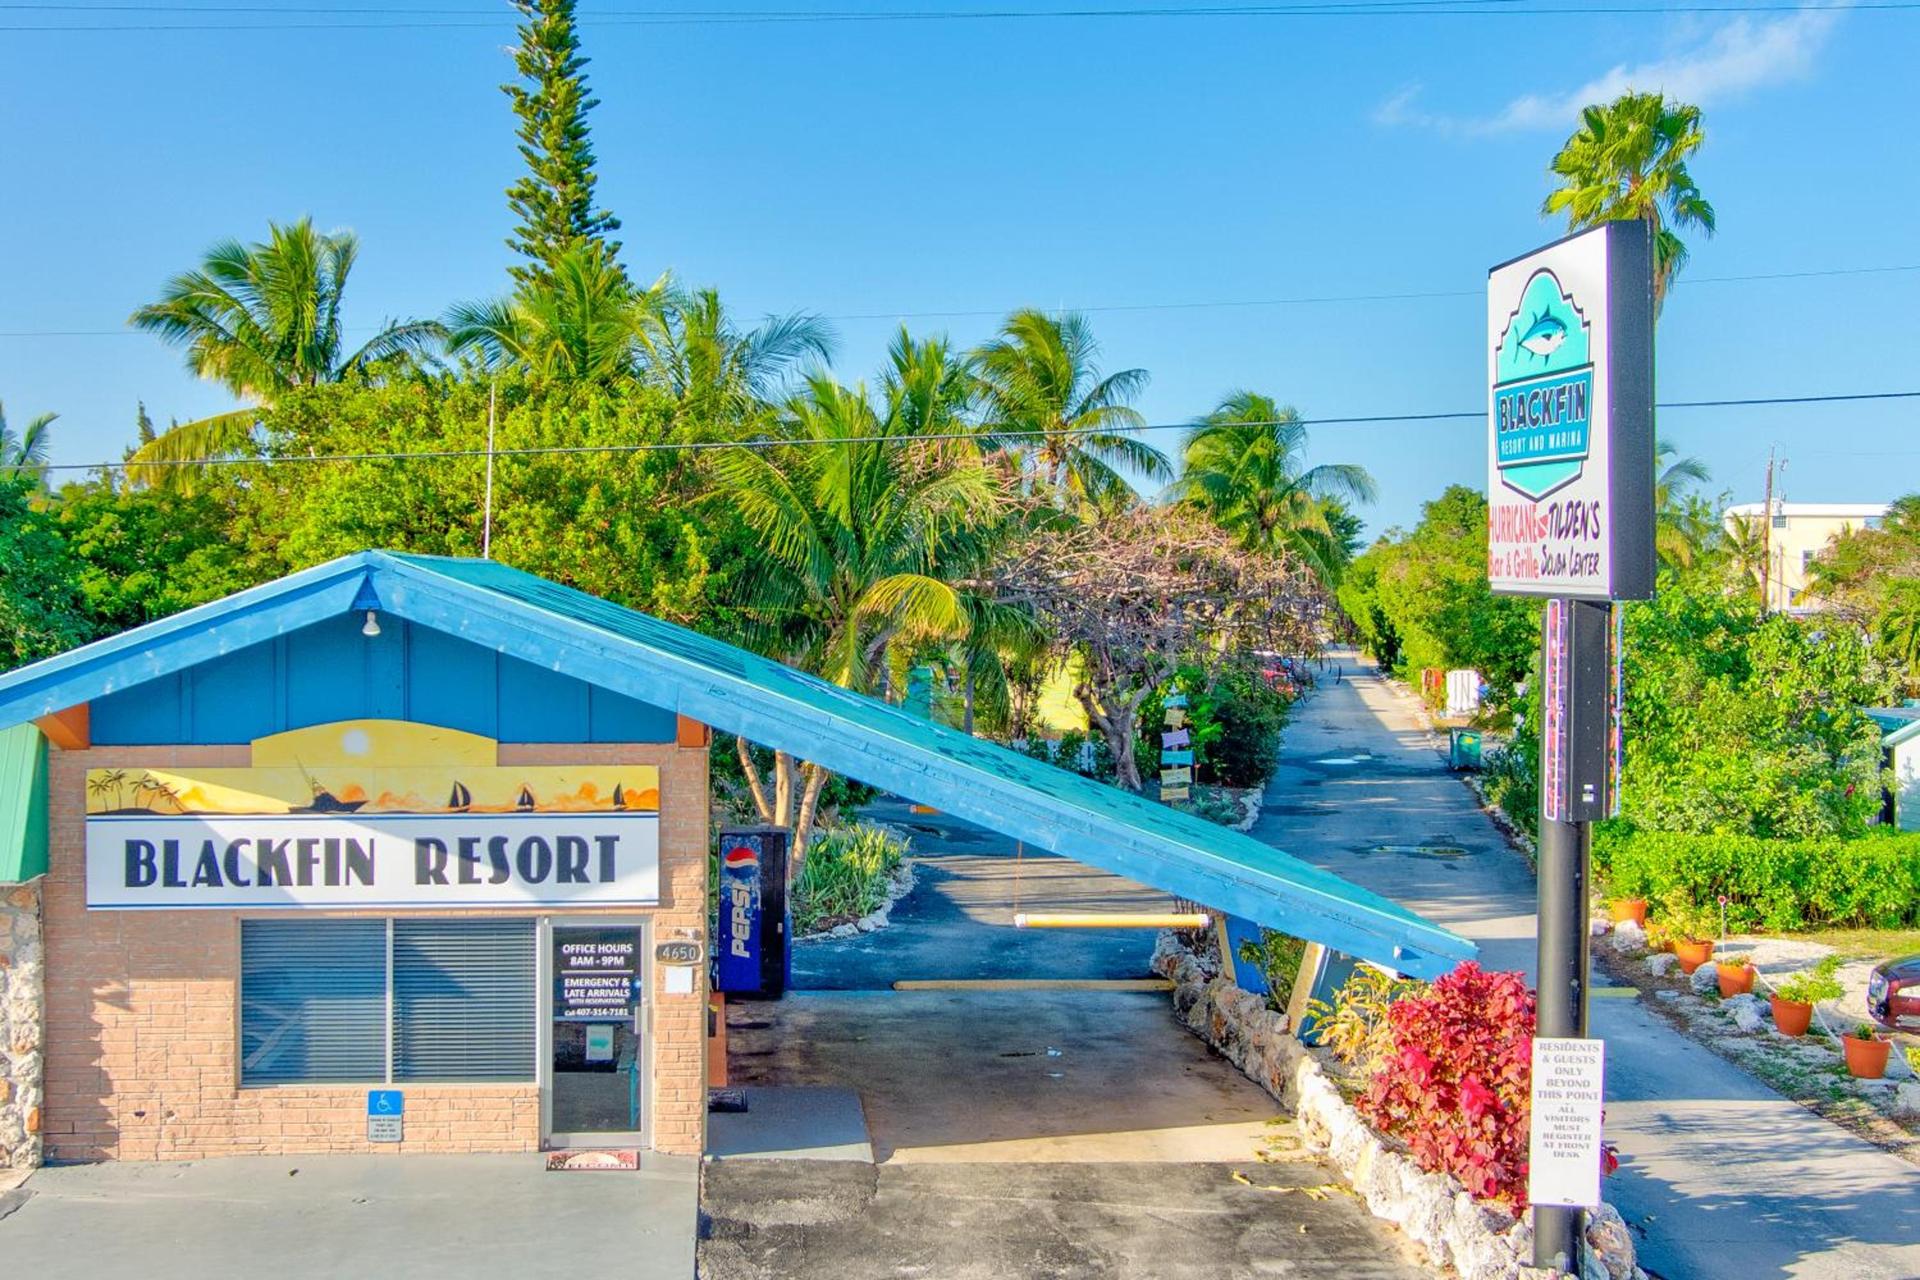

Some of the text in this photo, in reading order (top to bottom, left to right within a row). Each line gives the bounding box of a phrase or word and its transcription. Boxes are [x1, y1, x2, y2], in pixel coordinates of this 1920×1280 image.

[1500, 381, 1586, 434] BLACKFIN
[1501, 430, 1581, 456] RESORT AND MARINA
[1488, 504, 1537, 543] HURRICANE
[1549, 500, 1600, 541] TILDEN'S
[1488, 546, 1538, 579] Bar & Grille
[124, 834, 620, 888] BLACKFIN RESORT
[731, 882, 750, 958] PEPSI
[562, 944, 633, 954] OFFICE HOURS
[662, 946, 697, 960] 4650
[570, 956, 594, 966] 8AM
[601, 956, 625, 966] 9PM
[564, 978, 630, 987] EMERGENCY &
[564, 989, 631, 998] LATE ARRIVALS
[1538, 1042, 1600, 1052] RESIDENTS
[1542, 1055, 1596, 1065] & GUESTS
[1554, 1066, 1583, 1076] ONLY
[1546, 1079, 1591, 1088] BEYOND
[1538, 1090, 1599, 1100] THIS POINT
[1559, 1105, 1576, 1113] ALL
[1544, 1115, 1590, 1123] VISITORS
[1553, 1124, 1581, 1132] MUST
[1543, 1133, 1592, 1141] REGISTER
[1558, 1142, 1591, 1150] FRONT
[1553, 1151, 1580, 1159] DESK
